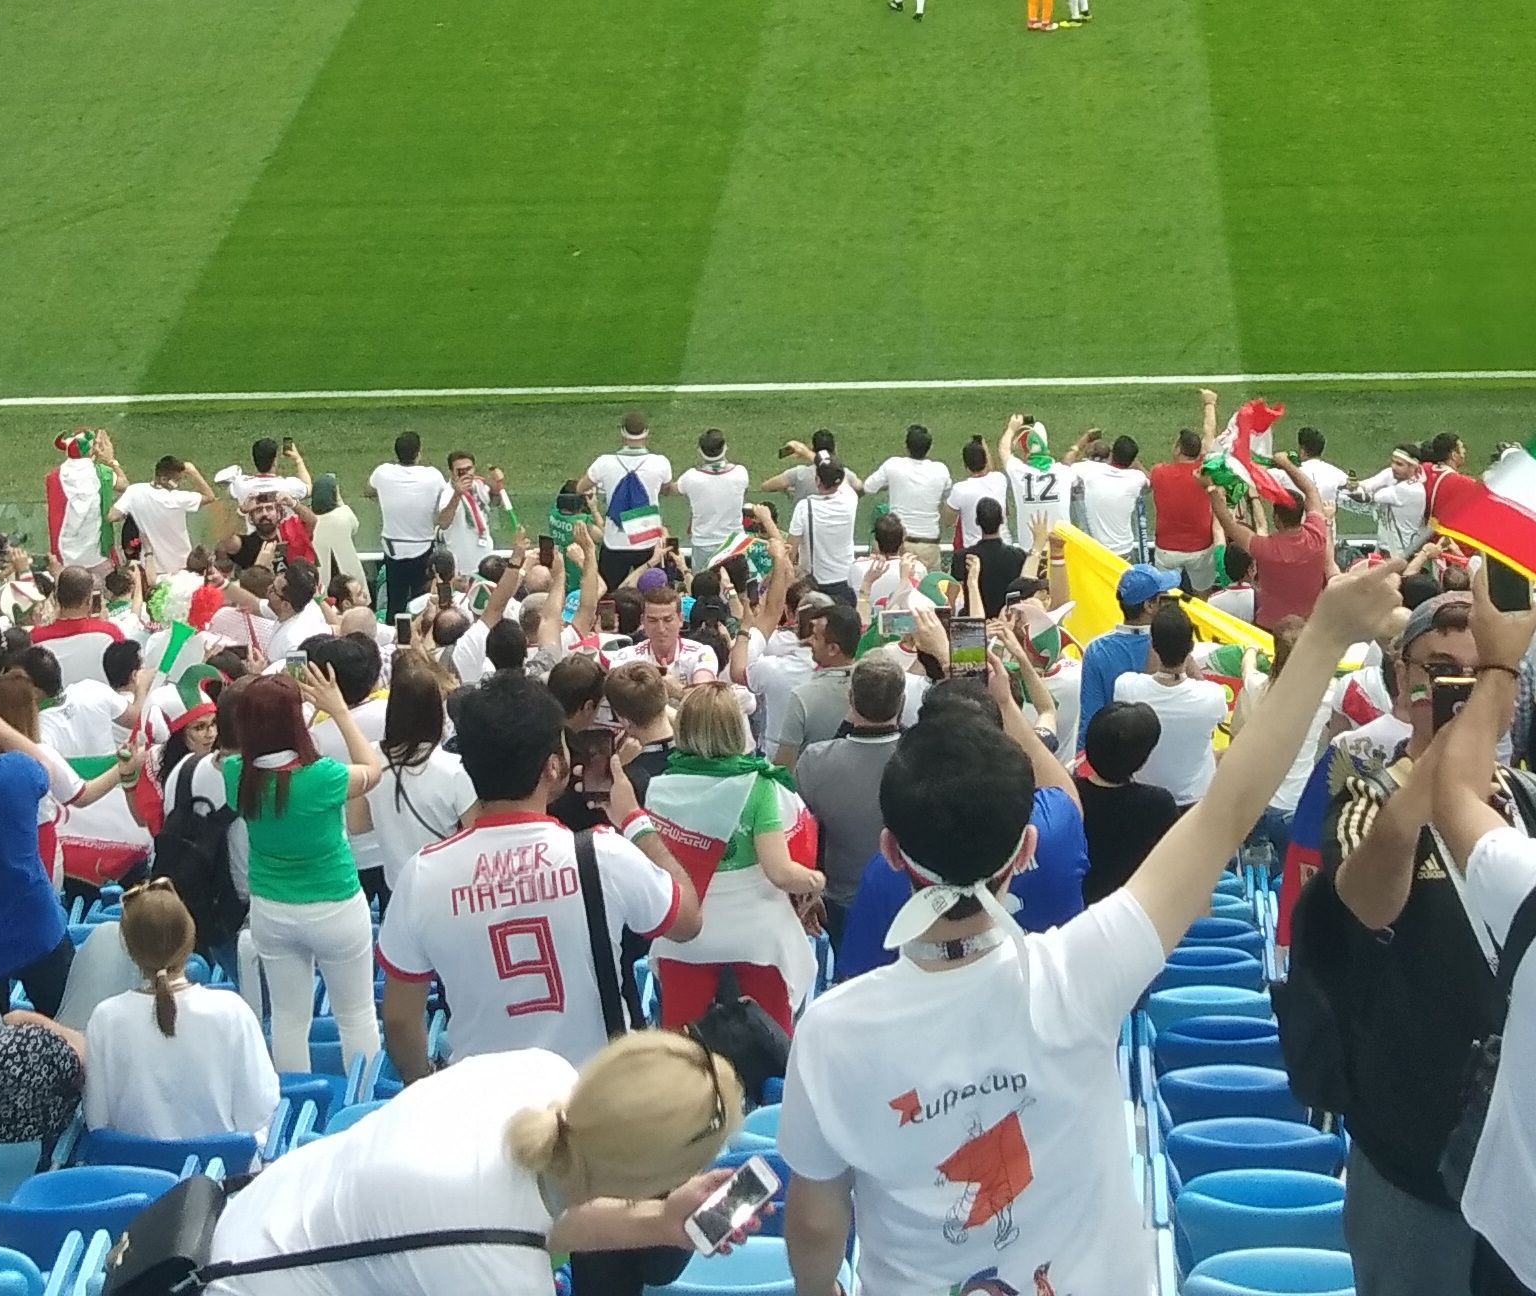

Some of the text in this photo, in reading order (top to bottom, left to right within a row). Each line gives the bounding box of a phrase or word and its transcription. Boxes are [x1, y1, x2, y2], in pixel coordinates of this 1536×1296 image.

[1021, 472, 1060, 504] 12
[473, 842, 553, 885] AMIR
[451, 866, 578, 916] MASOUD
[488, 916, 565, 1018] 9
